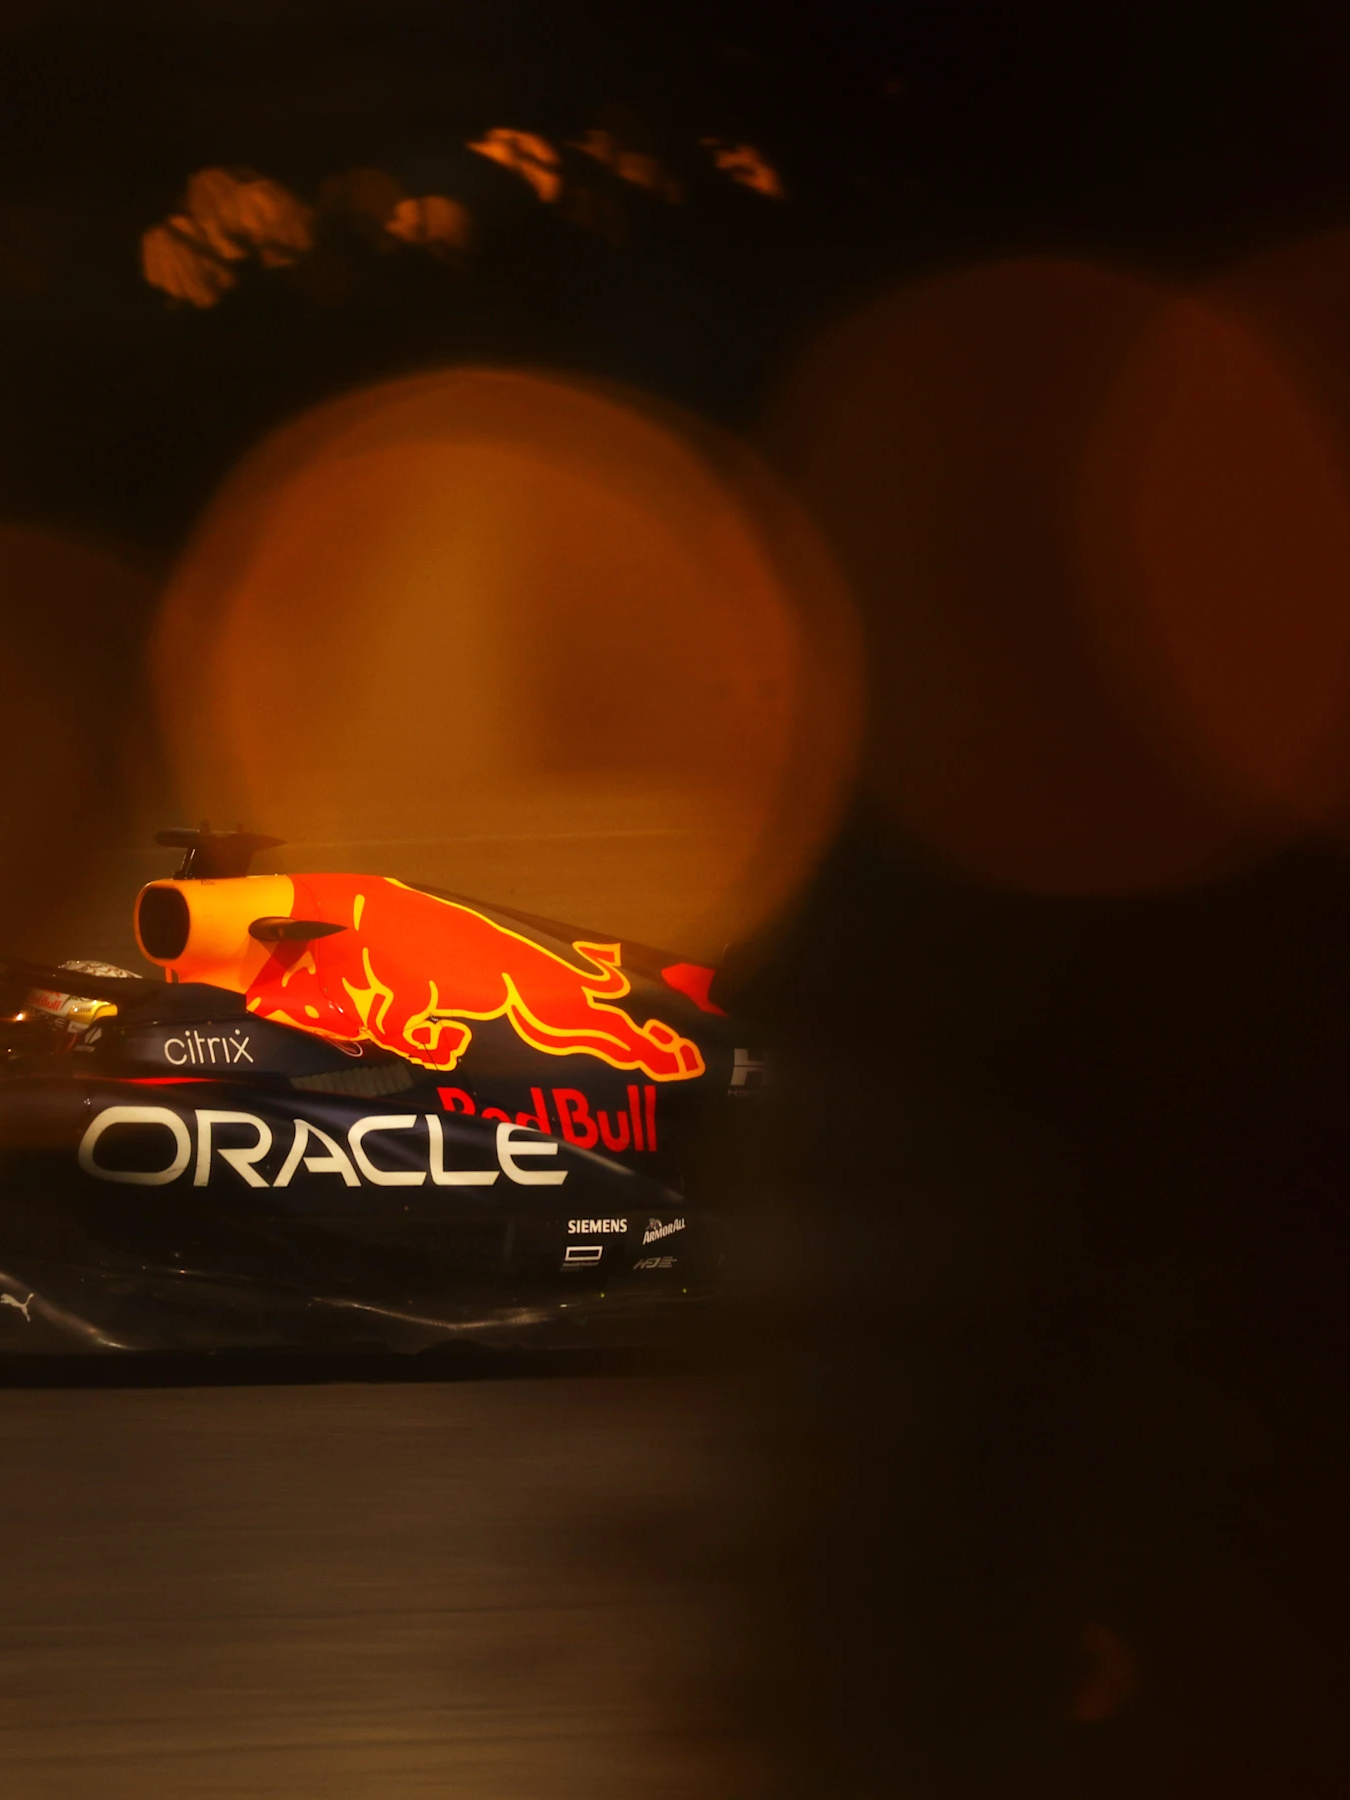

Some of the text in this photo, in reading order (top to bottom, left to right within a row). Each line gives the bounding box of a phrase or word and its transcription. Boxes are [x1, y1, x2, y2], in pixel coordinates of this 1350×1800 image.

[163, 1029, 254, 1066] citrix
[552, 1084, 658, 1152] Bull
[77, 1105, 570, 1188] ORACLE
[567, 1218, 628, 1234] SIEMENS
